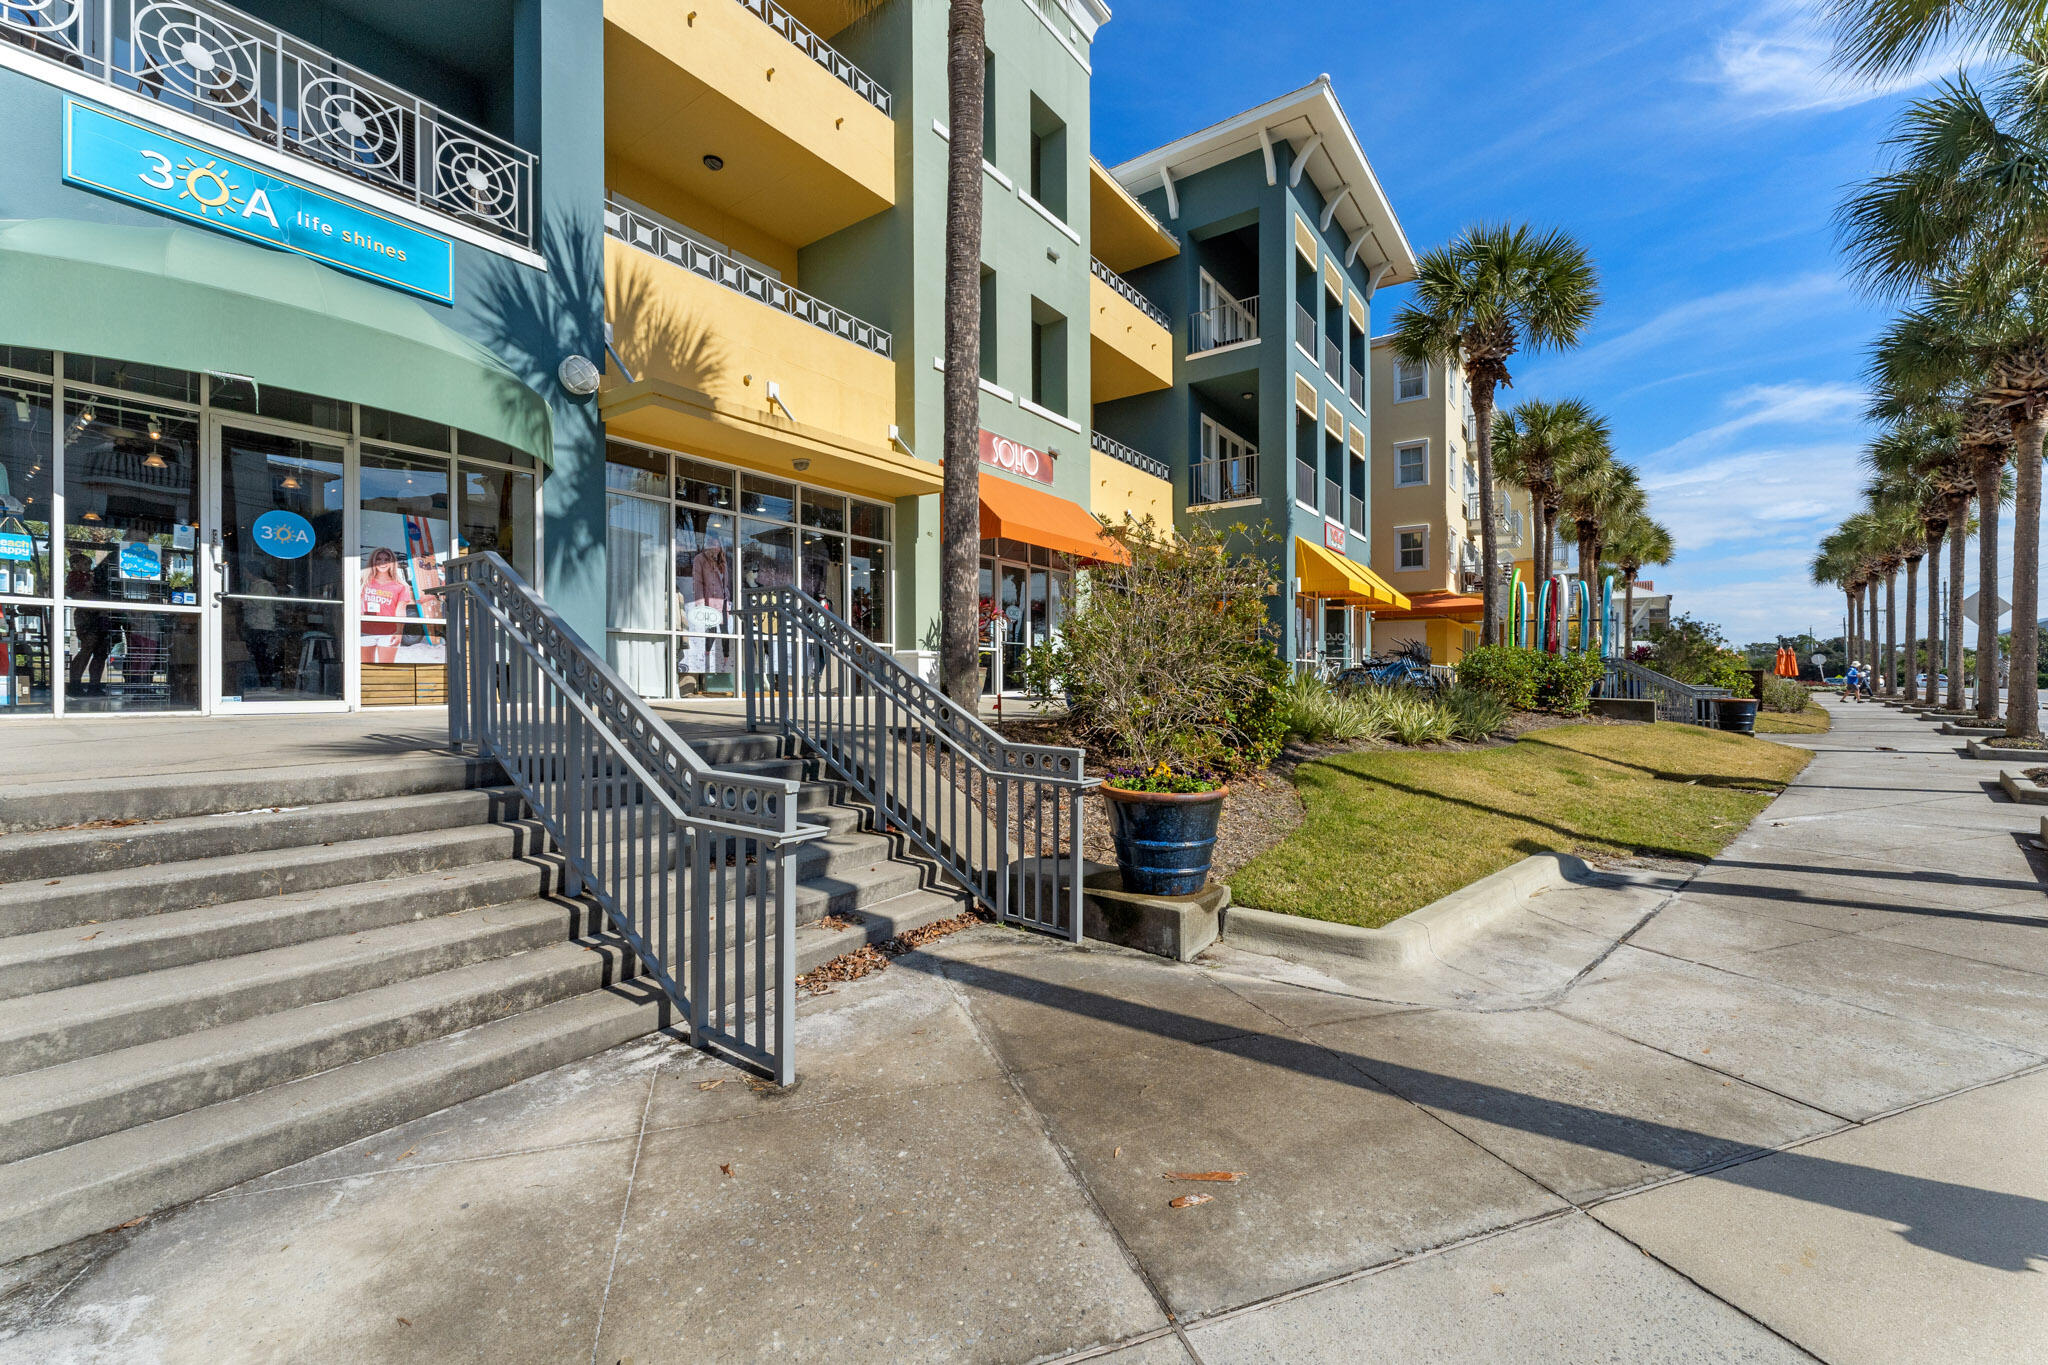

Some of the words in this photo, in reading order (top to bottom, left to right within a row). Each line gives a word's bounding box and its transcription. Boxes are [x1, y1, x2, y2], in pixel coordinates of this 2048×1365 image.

[297, 211, 333, 236] life
[341, 230, 408, 262] shines
[991, 436, 1039, 476] SOHO
[0, 539, 29, 549] each
[0, 546, 29, 557] appy
[364, 593, 393, 606] happy
